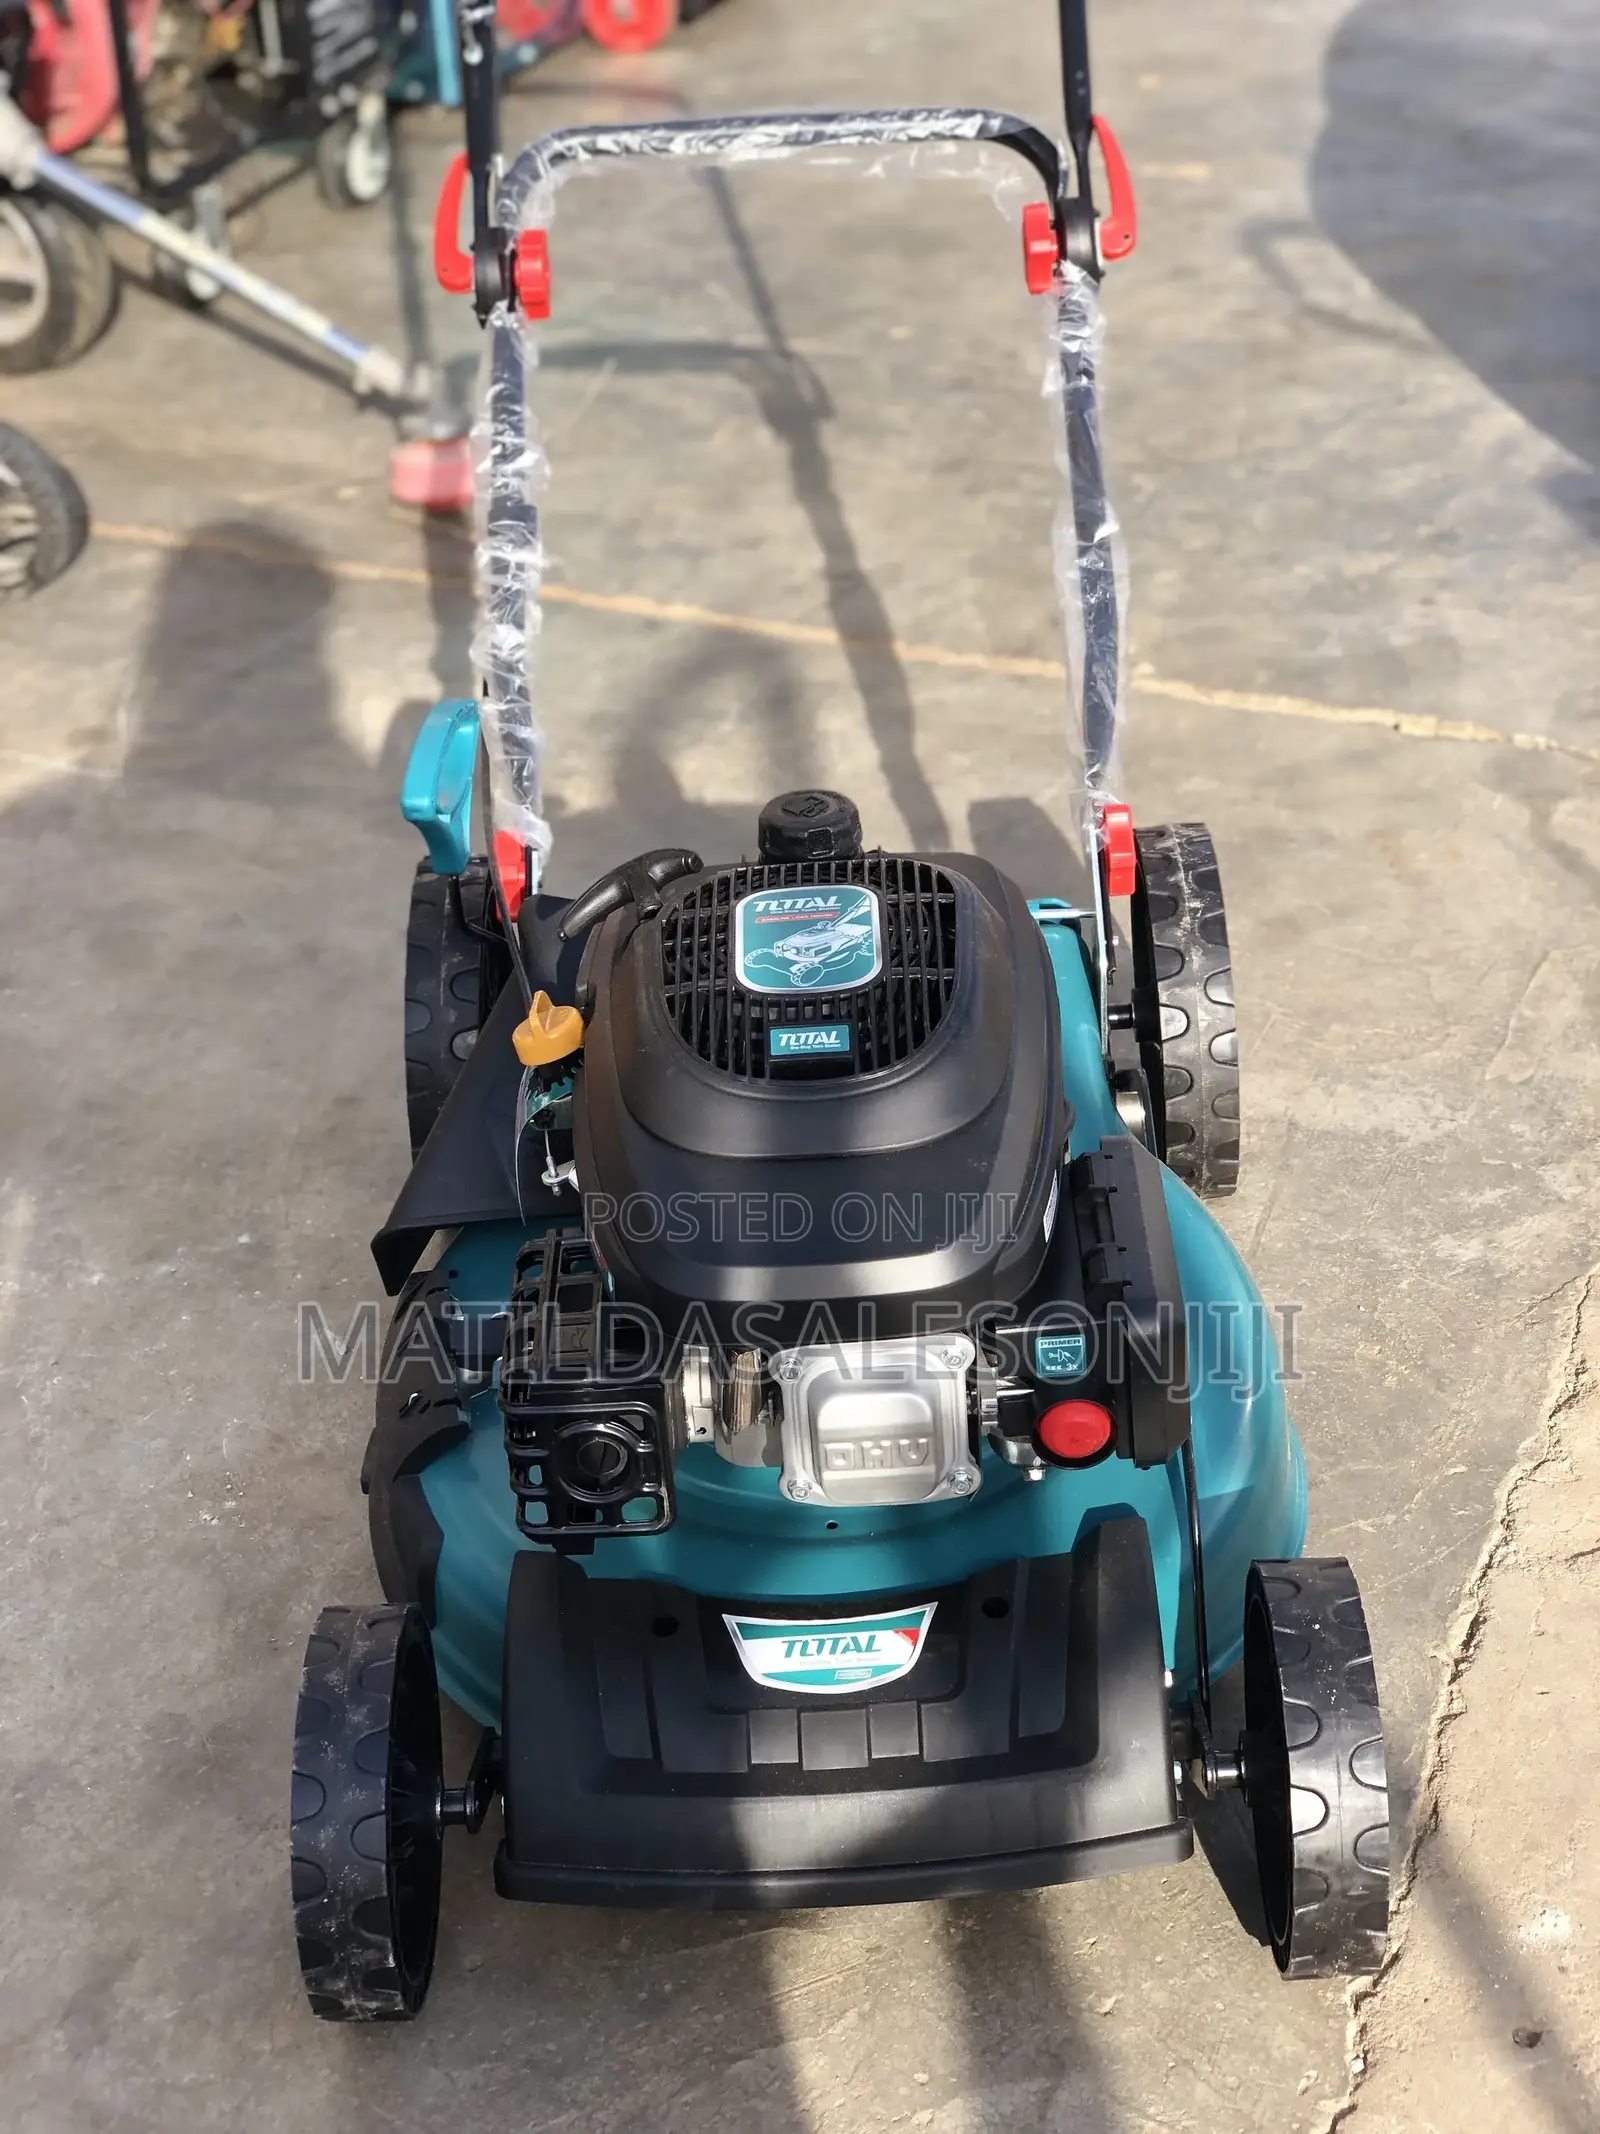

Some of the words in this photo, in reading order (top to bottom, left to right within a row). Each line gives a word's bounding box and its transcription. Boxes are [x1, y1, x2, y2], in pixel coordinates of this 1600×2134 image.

[753, 896, 842, 912] TOTAL
[778, 1030, 841, 1047] TOTAL
[1040, 1338, 1081, 1347] PRIMER
[781, 1634, 882, 1658] TOTAL
